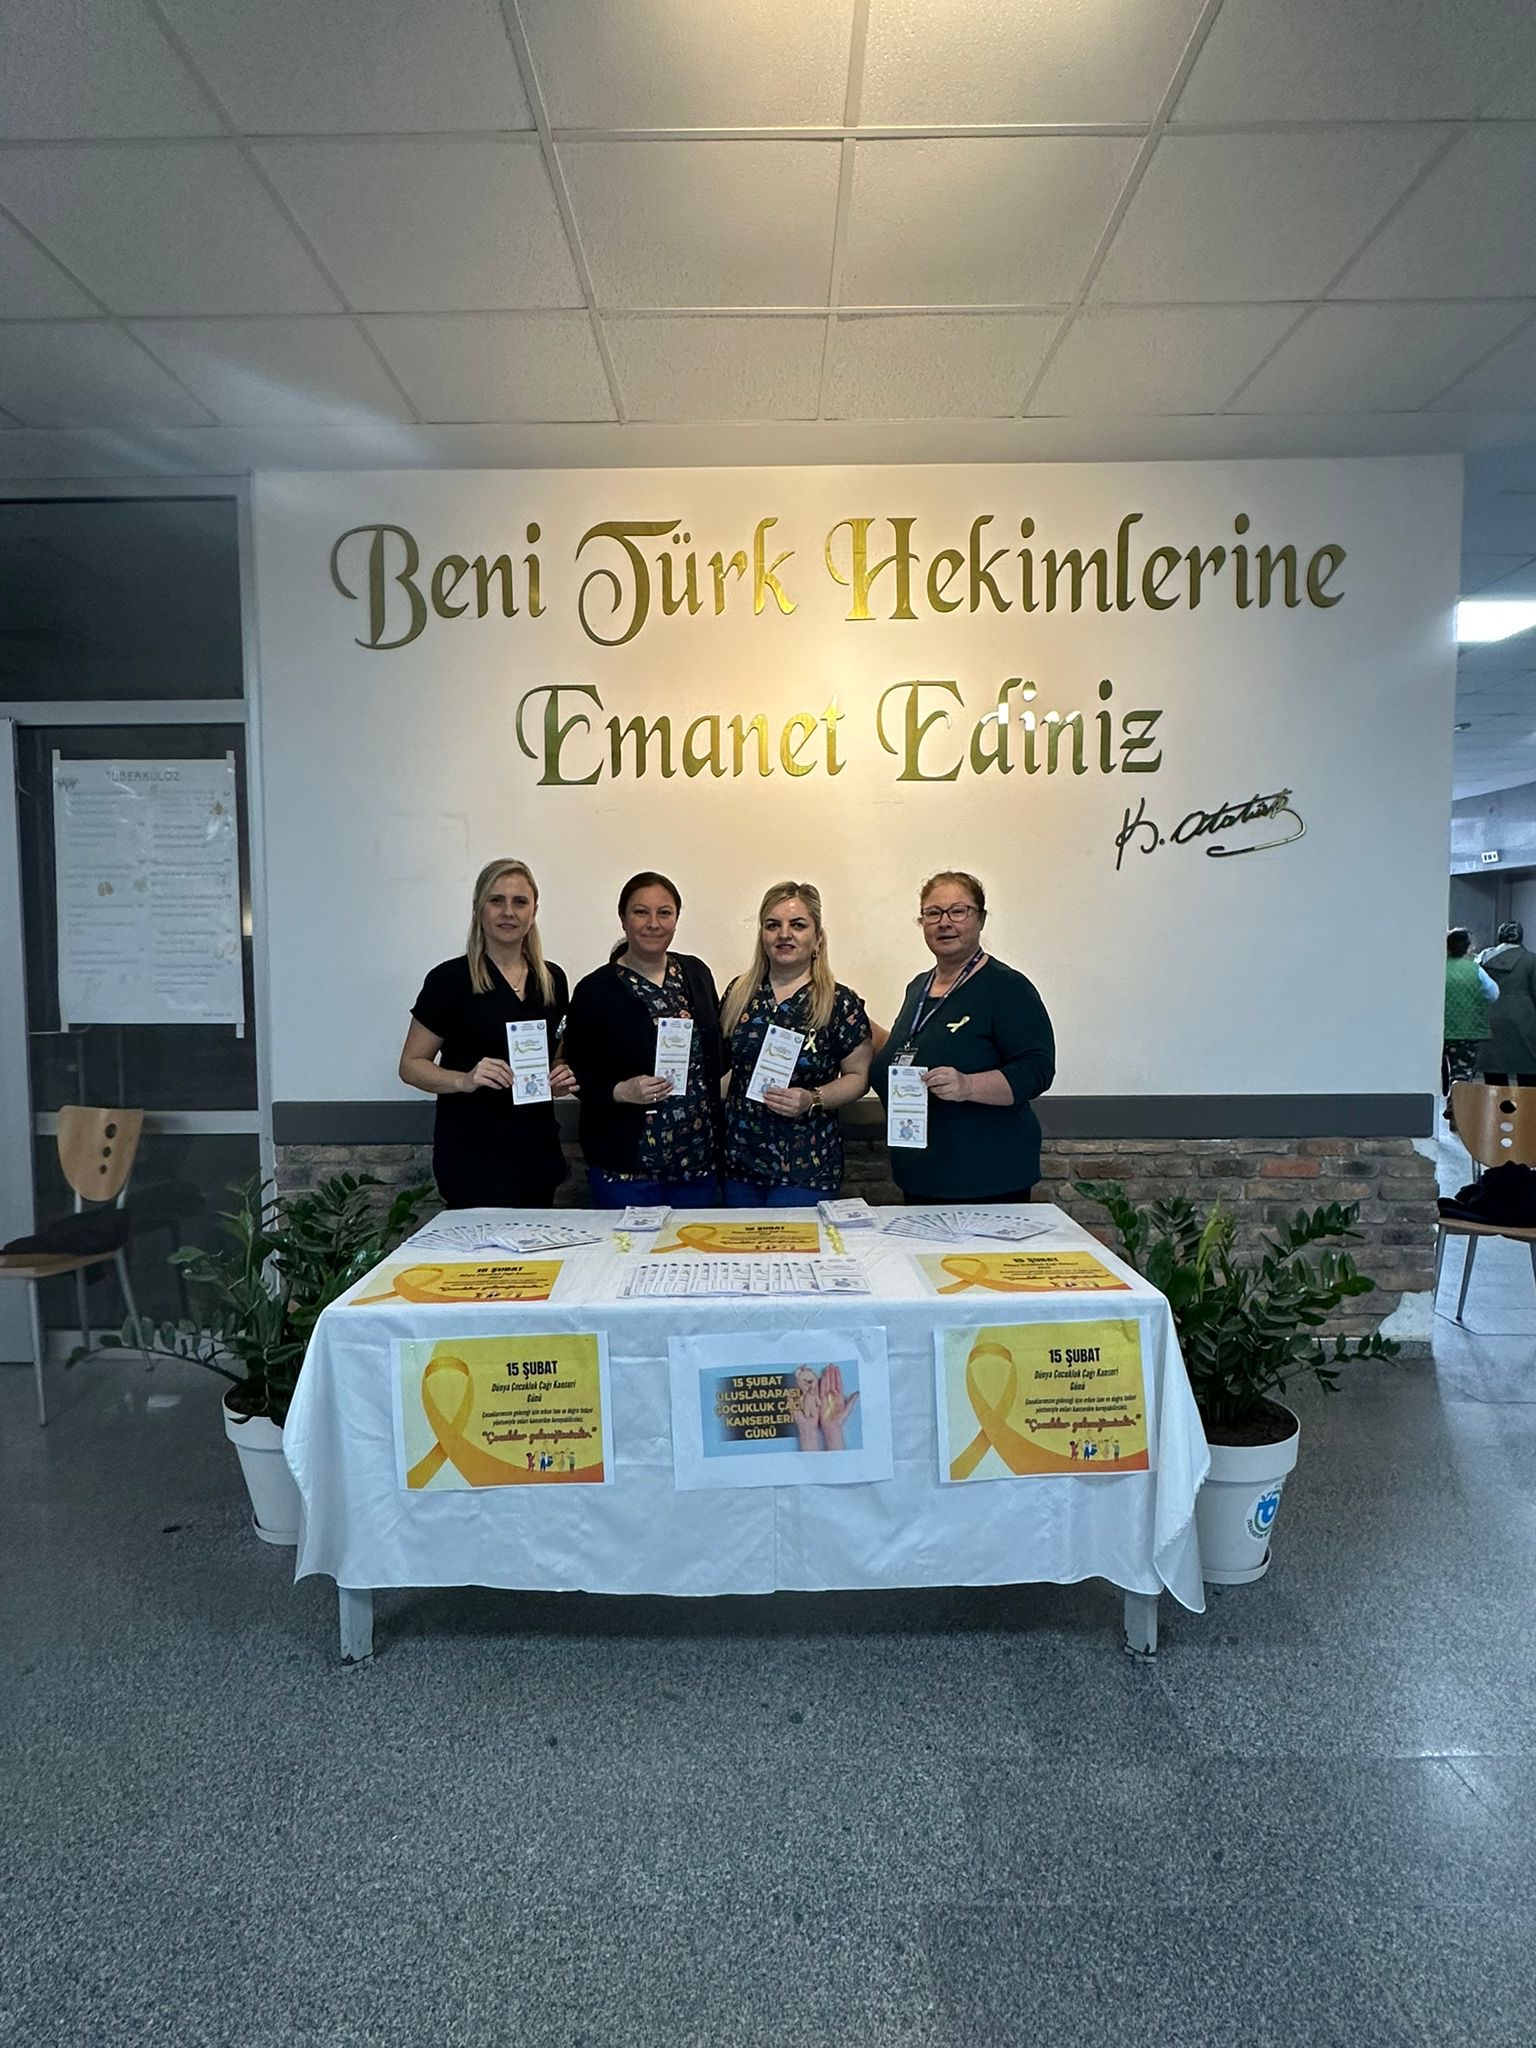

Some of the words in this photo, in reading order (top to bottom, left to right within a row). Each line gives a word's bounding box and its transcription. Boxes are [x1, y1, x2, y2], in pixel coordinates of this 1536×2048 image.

[331, 522, 545, 650] Beni
[575, 516, 798, 646] Türk
[825, 512, 1346, 622] Hekimlerine
[515, 684, 846, 786] Emanet
[876, 678, 1163, 783] Ediniz
[1048, 1349, 1062, 1363] 15
[1065, 1347, 1100, 1367] ŞUBAT
[506, 1362, 519, 1376] 15
[522, 1360, 558, 1380] ŞUBAT
[732, 1378, 743, 1388] 15
[746, 1376, 783, 1389] ŞUBAT
[744, 1426, 777, 1438] GÜNÜ
